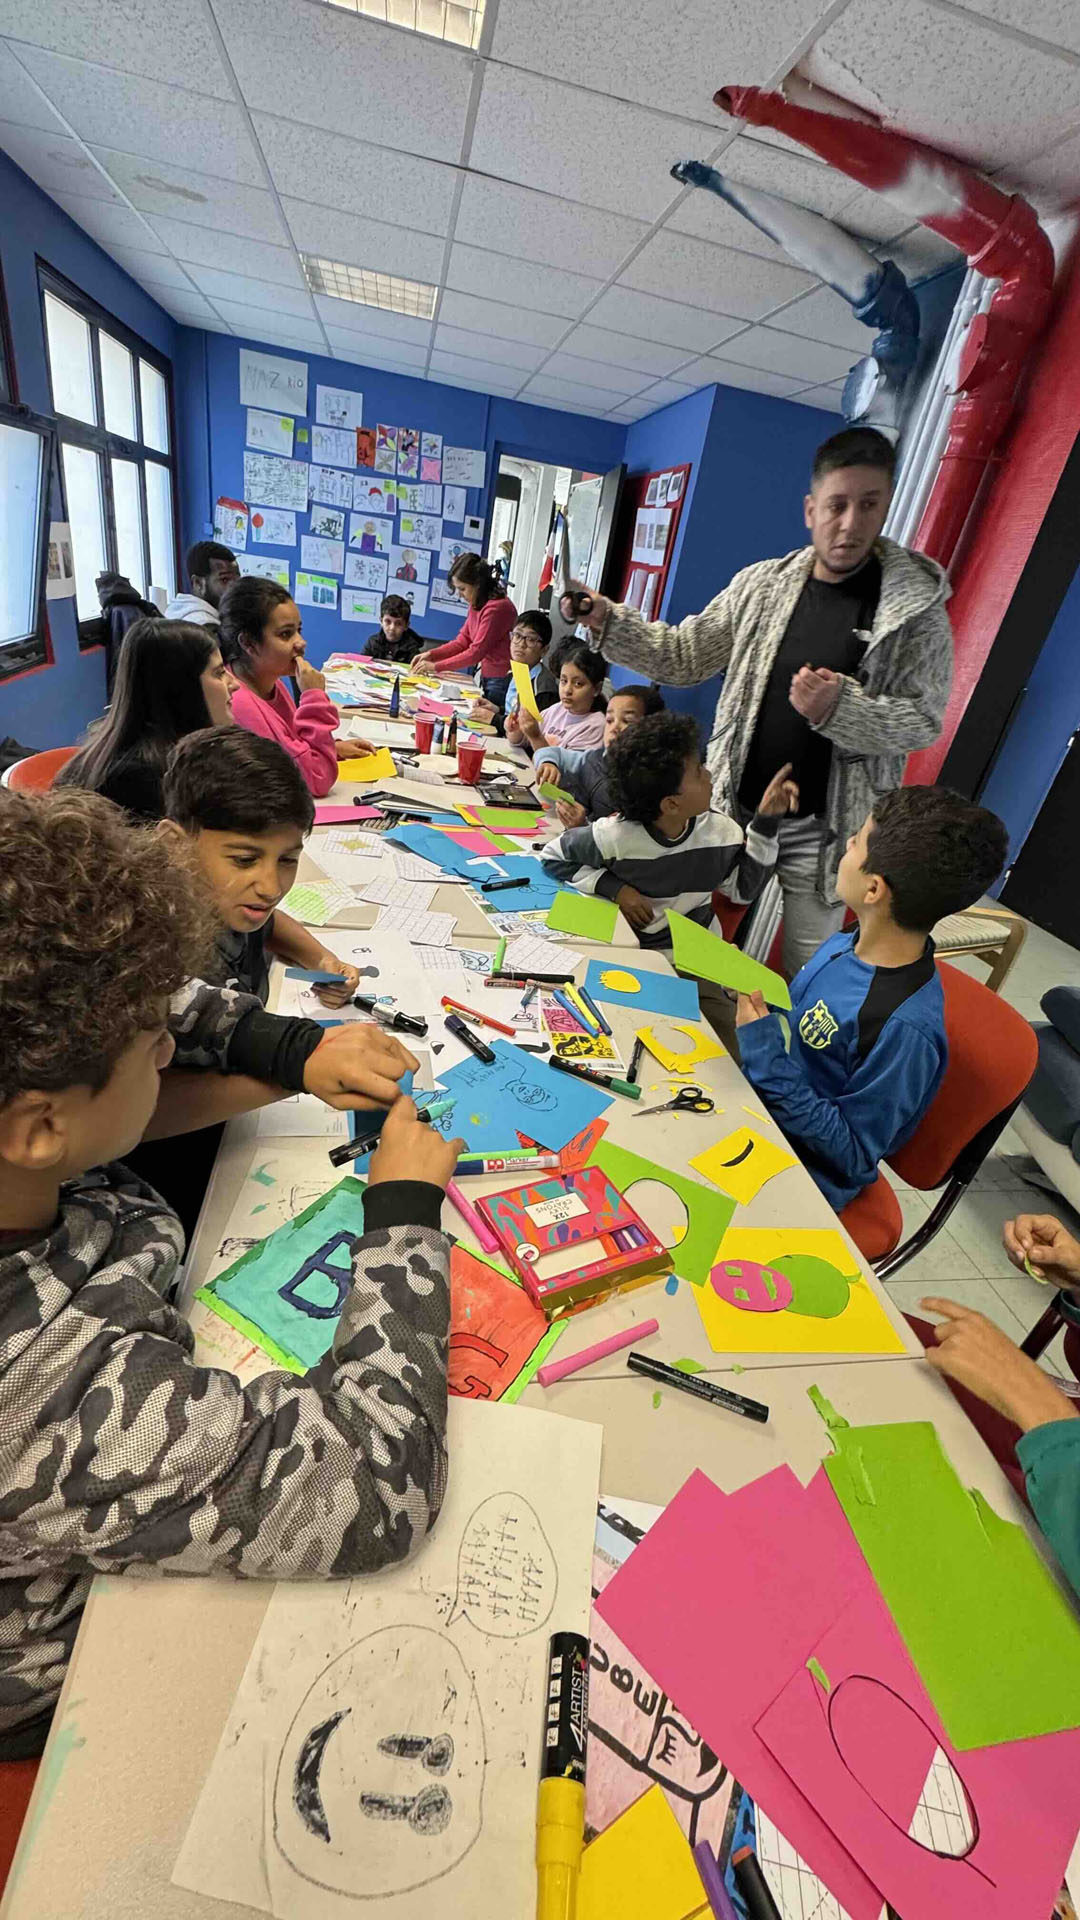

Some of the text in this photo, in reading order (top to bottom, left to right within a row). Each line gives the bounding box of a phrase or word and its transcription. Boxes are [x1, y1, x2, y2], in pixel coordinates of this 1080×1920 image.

[535, 1198, 573, 1214] CRAYONS
[552, 1211, 570, 1220] 12X
[587, 1641, 659, 1717] UBE
